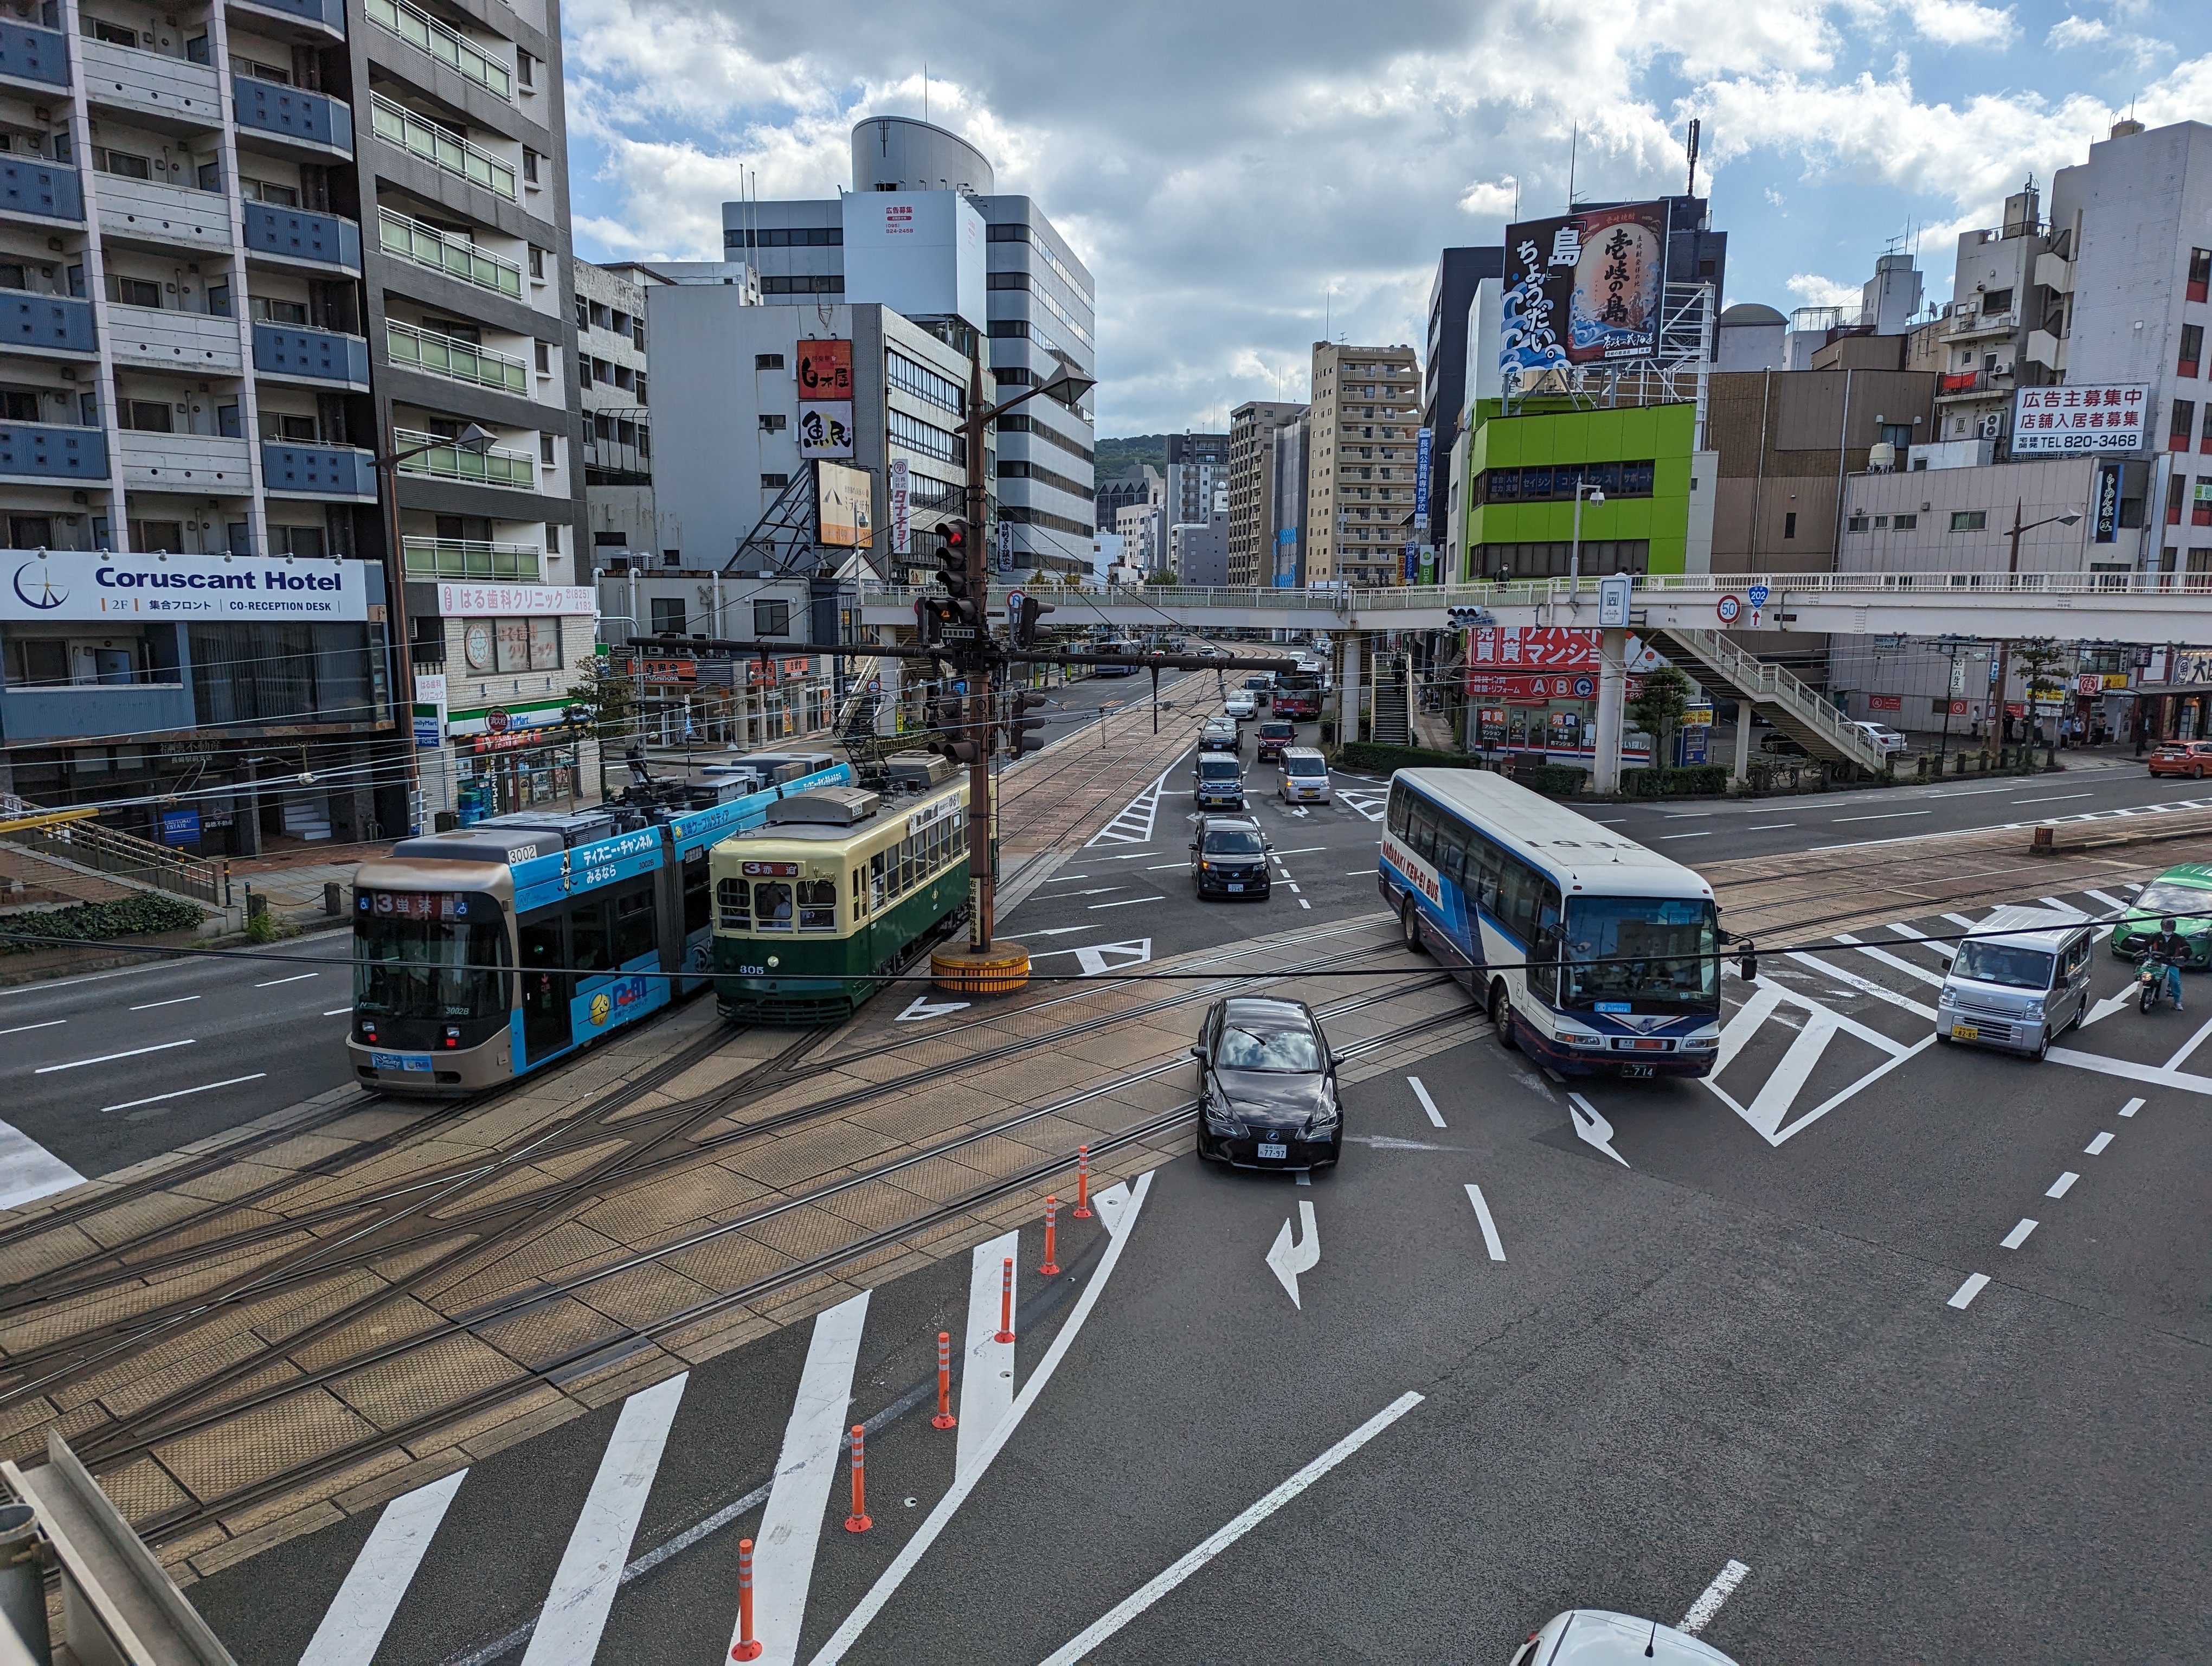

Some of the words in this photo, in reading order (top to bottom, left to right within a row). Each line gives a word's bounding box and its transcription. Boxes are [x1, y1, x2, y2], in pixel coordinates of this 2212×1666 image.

[1606, 212, 1636, 224] 壱岐焼酎
[1602, 228, 1632, 323] 壱岐の島
[1517, 239, 1555, 358] ちょうだい。
[802, 356, 850, 388] 白木屋
[2022, 389, 2143, 408] 広告主募集中
[2020, 411, 2139, 428] 店舗入居者募集
[802, 410, 852, 448] 魚民
[2041, 437, 2061, 448] TEL
[2064, 434, 2137, 448] 820-3468
[1417, 439, 1429, 512] 長崎公務員専門学校
[1523, 477, 1551, 488] セイシン
[1624, 473, 1652, 483] サポート
[895, 490, 907, 551] タナチョー
[95, 567, 256, 589] Coruscant
[265, 571, 342, 591] Hotel
[445, 586, 452, 607] 2F
[460, 589, 563, 610] はる歯科クリニック
[571, 588, 590, 599] (825)
[1751, 591, 1766, 600] 202
[112, 600, 128, 610] 2F
[149, 600, 211, 611] 集合フロント
[230, 601, 304, 611] CO-RECEPTION
[306, 601, 332, 611] DESK
[575, 601, 591, 611] 4182
[1722, 603, 1735, 616] 50
[1525, 642, 1600, 665] マンショ
[420, 679, 441, 689] はる歯科
[870, 683, 878, 691] 40
[1474, 684, 1520, 694] 建築・リフォーム
[1533, 679, 1545, 693] A
[1557, 680, 1567, 694] B
[420, 690, 444, 700] クリニック
[490, 716, 506, 726] 消火栓
[510, 847, 536, 863] 3002
[583, 834, 653, 866] ディズニー・チャンネル
[639, 859, 654, 870] 3002B
[744, 863, 761, 874] 3
[763, 866, 797, 875] 赤迫
[1382, 840, 1406, 873] NAGASAKI
[1406, 860, 1426, 890] KEN-EI
[1426, 877, 1439, 902] BUS
[587, 864, 616, 884] みるなら
[372, 893, 393, 914] 13
[969, 880, 978, 943] 右折車軌道外待機
[740, 965, 764, 975] 305
[1634, 1068, 1653, 1076] 714
[1264, 1149, 1285, 1157] 77-97
